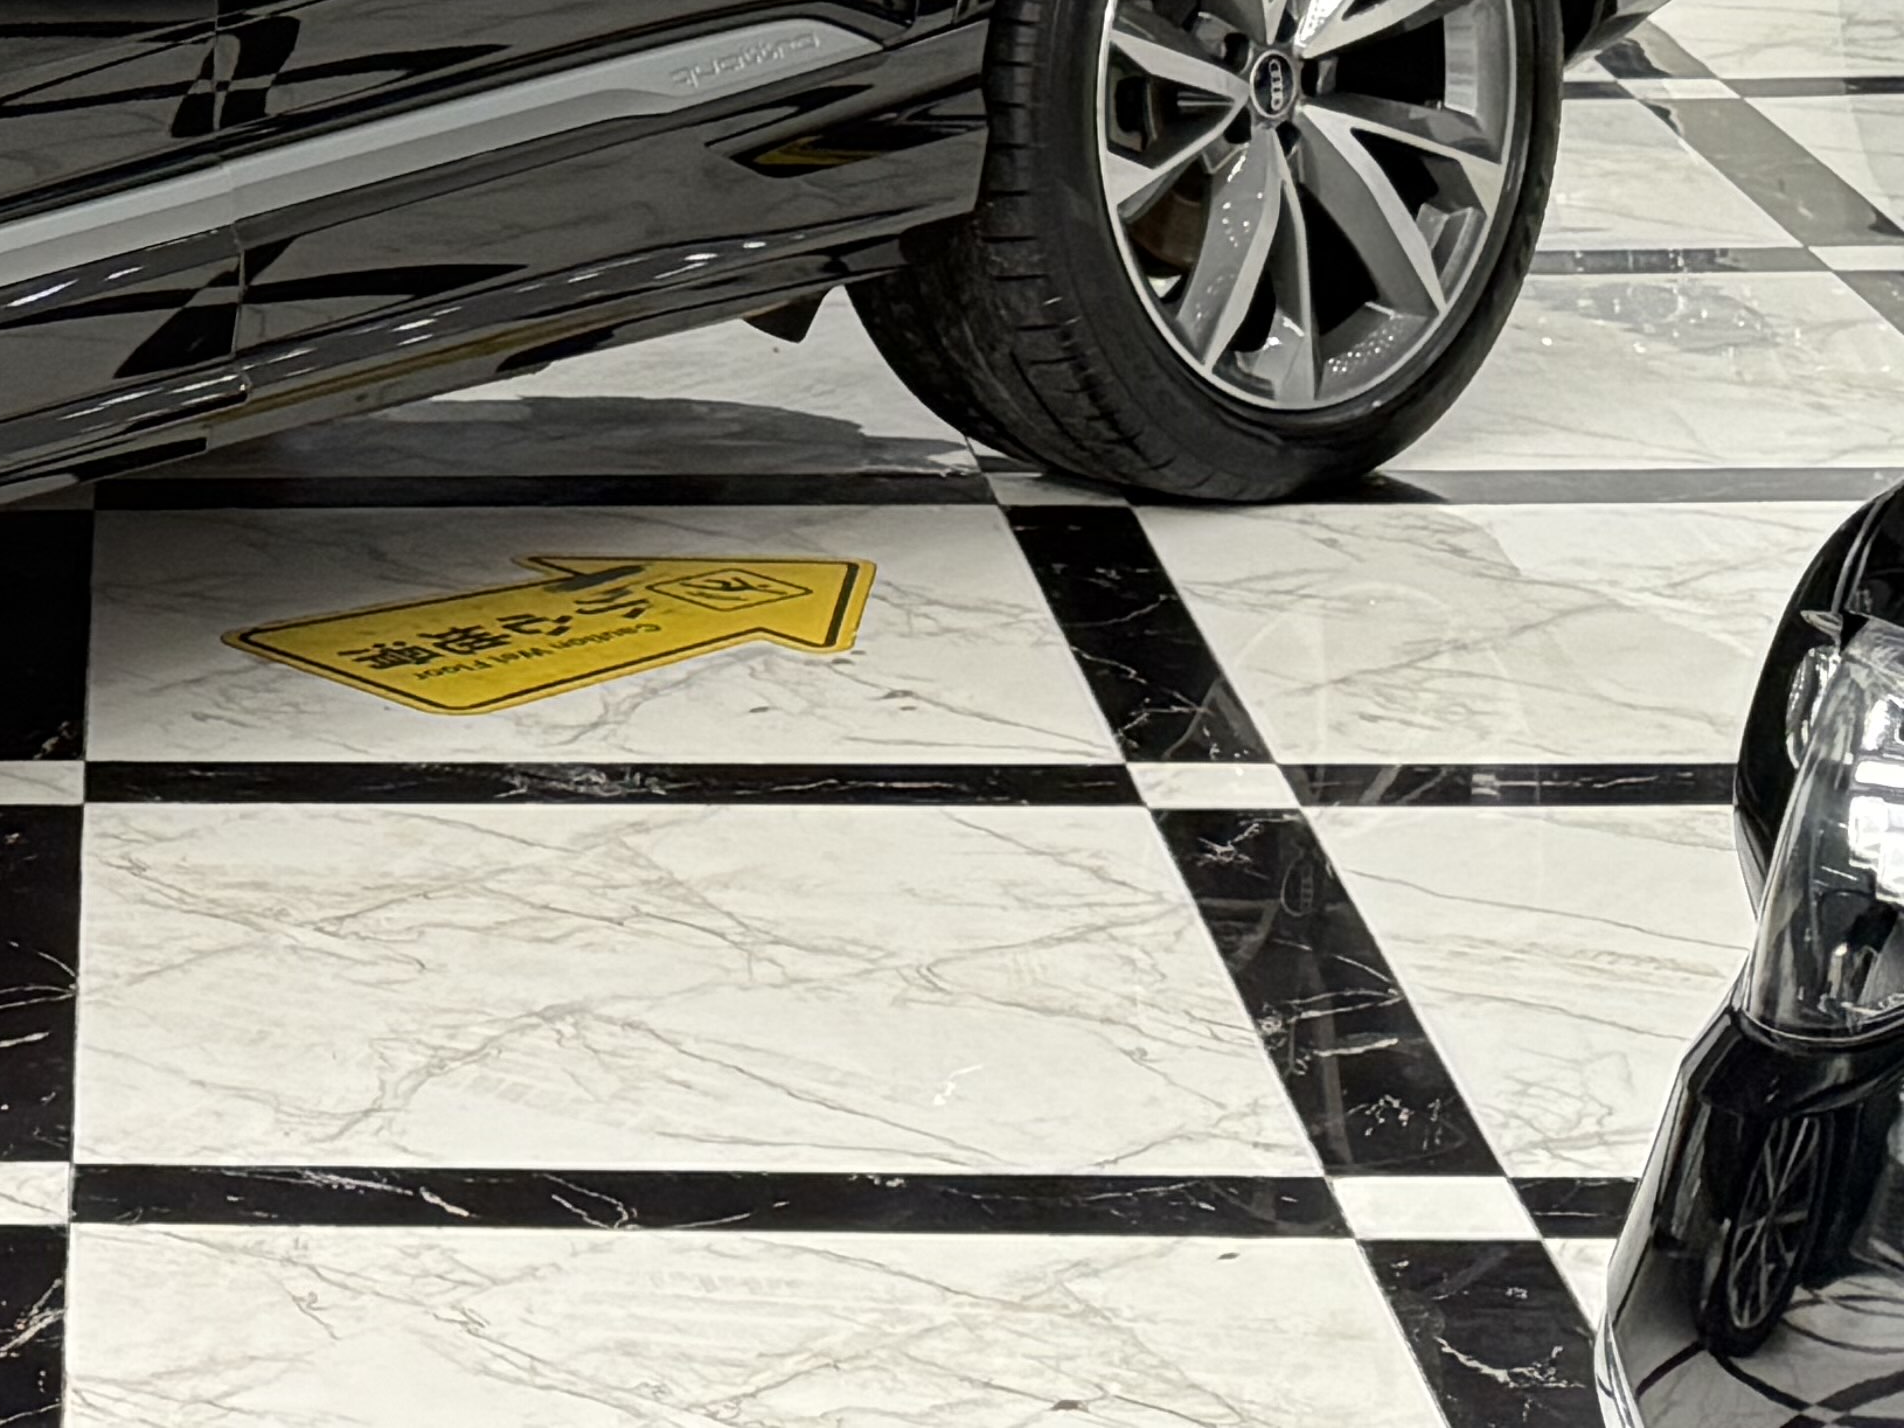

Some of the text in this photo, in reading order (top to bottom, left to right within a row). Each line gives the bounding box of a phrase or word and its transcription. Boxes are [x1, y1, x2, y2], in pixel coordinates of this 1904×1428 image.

[337, 585, 650, 670] 小心地滑
[416, 622, 663, 681] Caution Wet Floor
